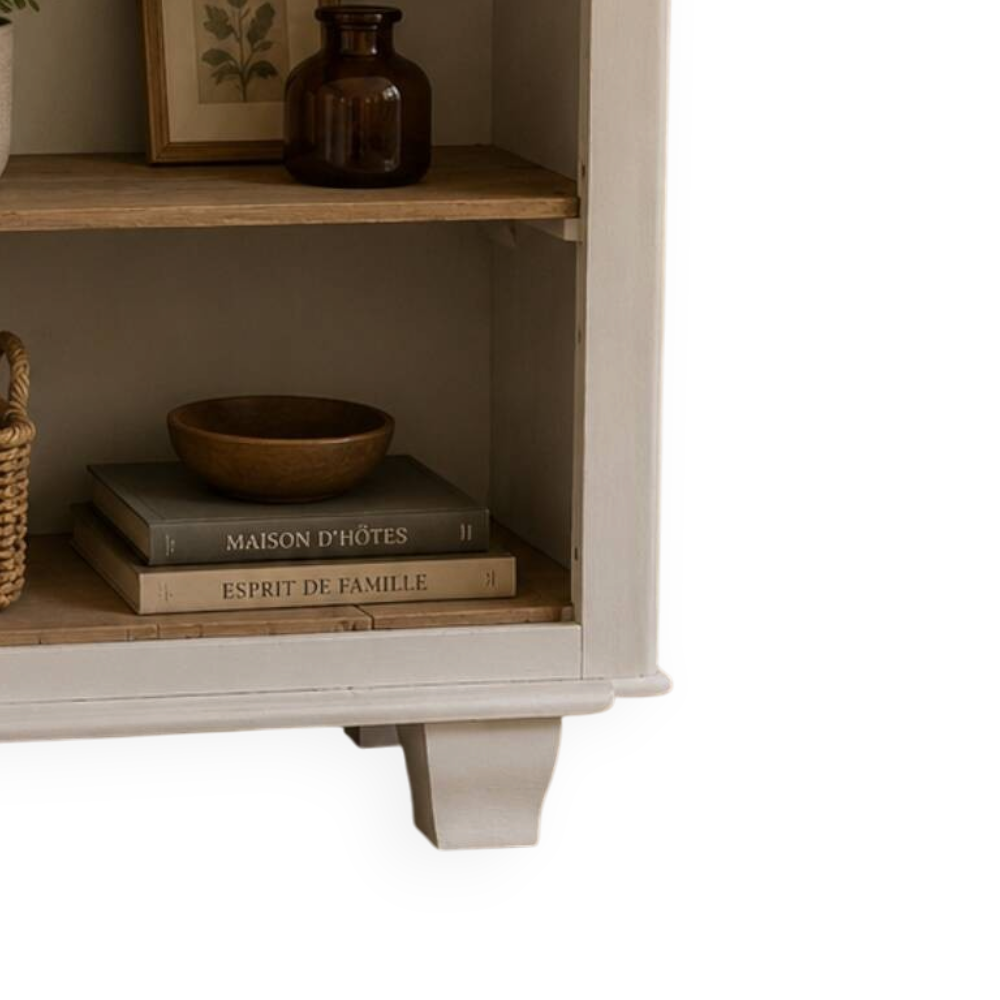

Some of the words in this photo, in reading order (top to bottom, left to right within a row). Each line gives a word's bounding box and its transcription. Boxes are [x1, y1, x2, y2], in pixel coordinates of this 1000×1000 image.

[226, 530, 311, 551] MAISON
[222, 580, 297, 599] ESPRIT
[303, 578, 332, 596] DE
[339, 573, 428, 595] FAMILLE
